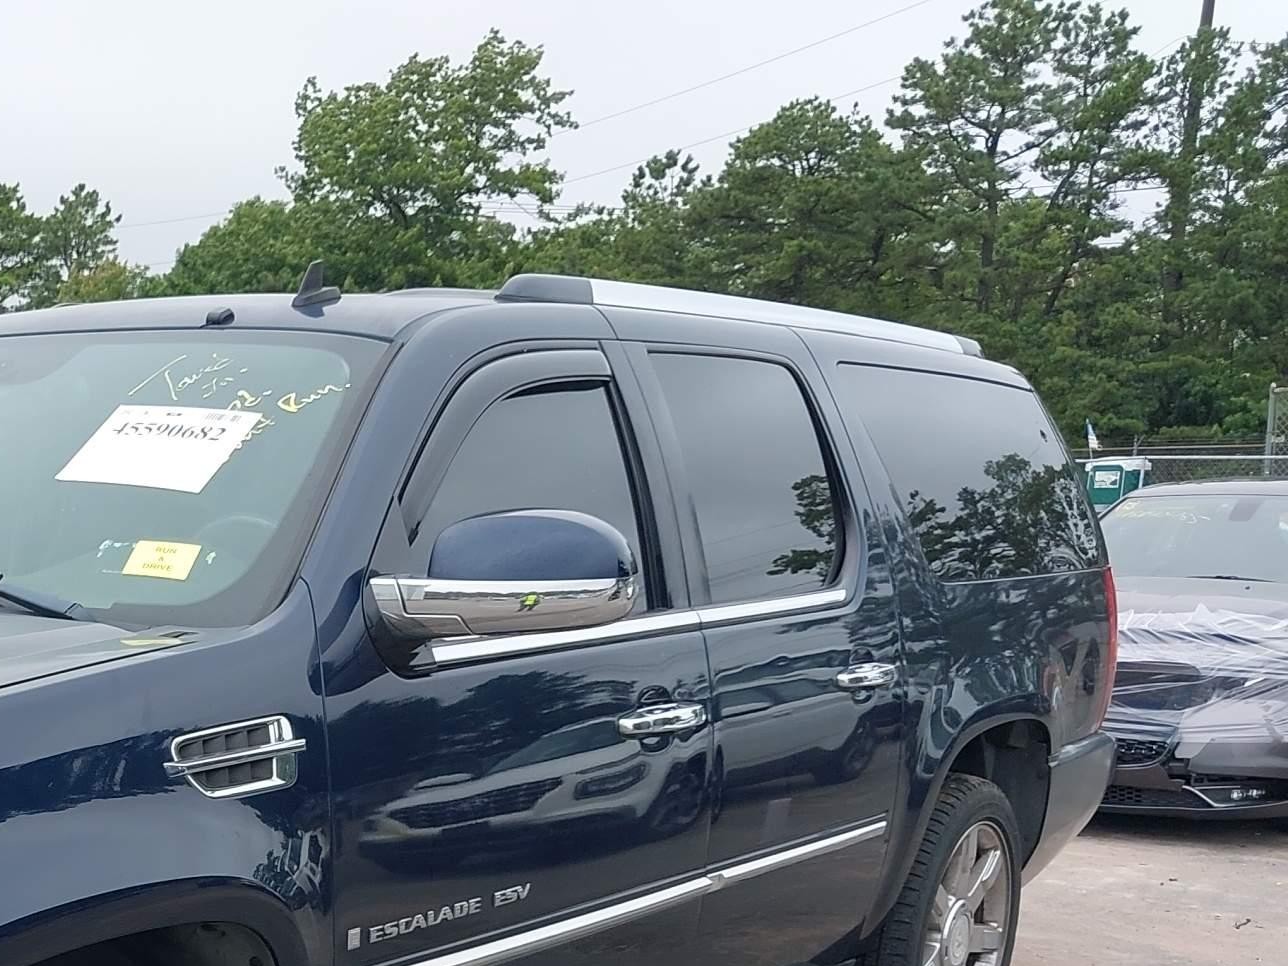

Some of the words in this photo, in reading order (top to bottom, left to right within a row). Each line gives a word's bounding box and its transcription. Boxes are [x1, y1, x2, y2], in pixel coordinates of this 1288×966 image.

[112, 422, 227, 441] 45590682
[155, 546, 178, 554] RUN
[142, 562, 174, 572] DRIVE
[368, 897, 482, 944] ESCALADE
[493, 883, 532, 908] ESV
